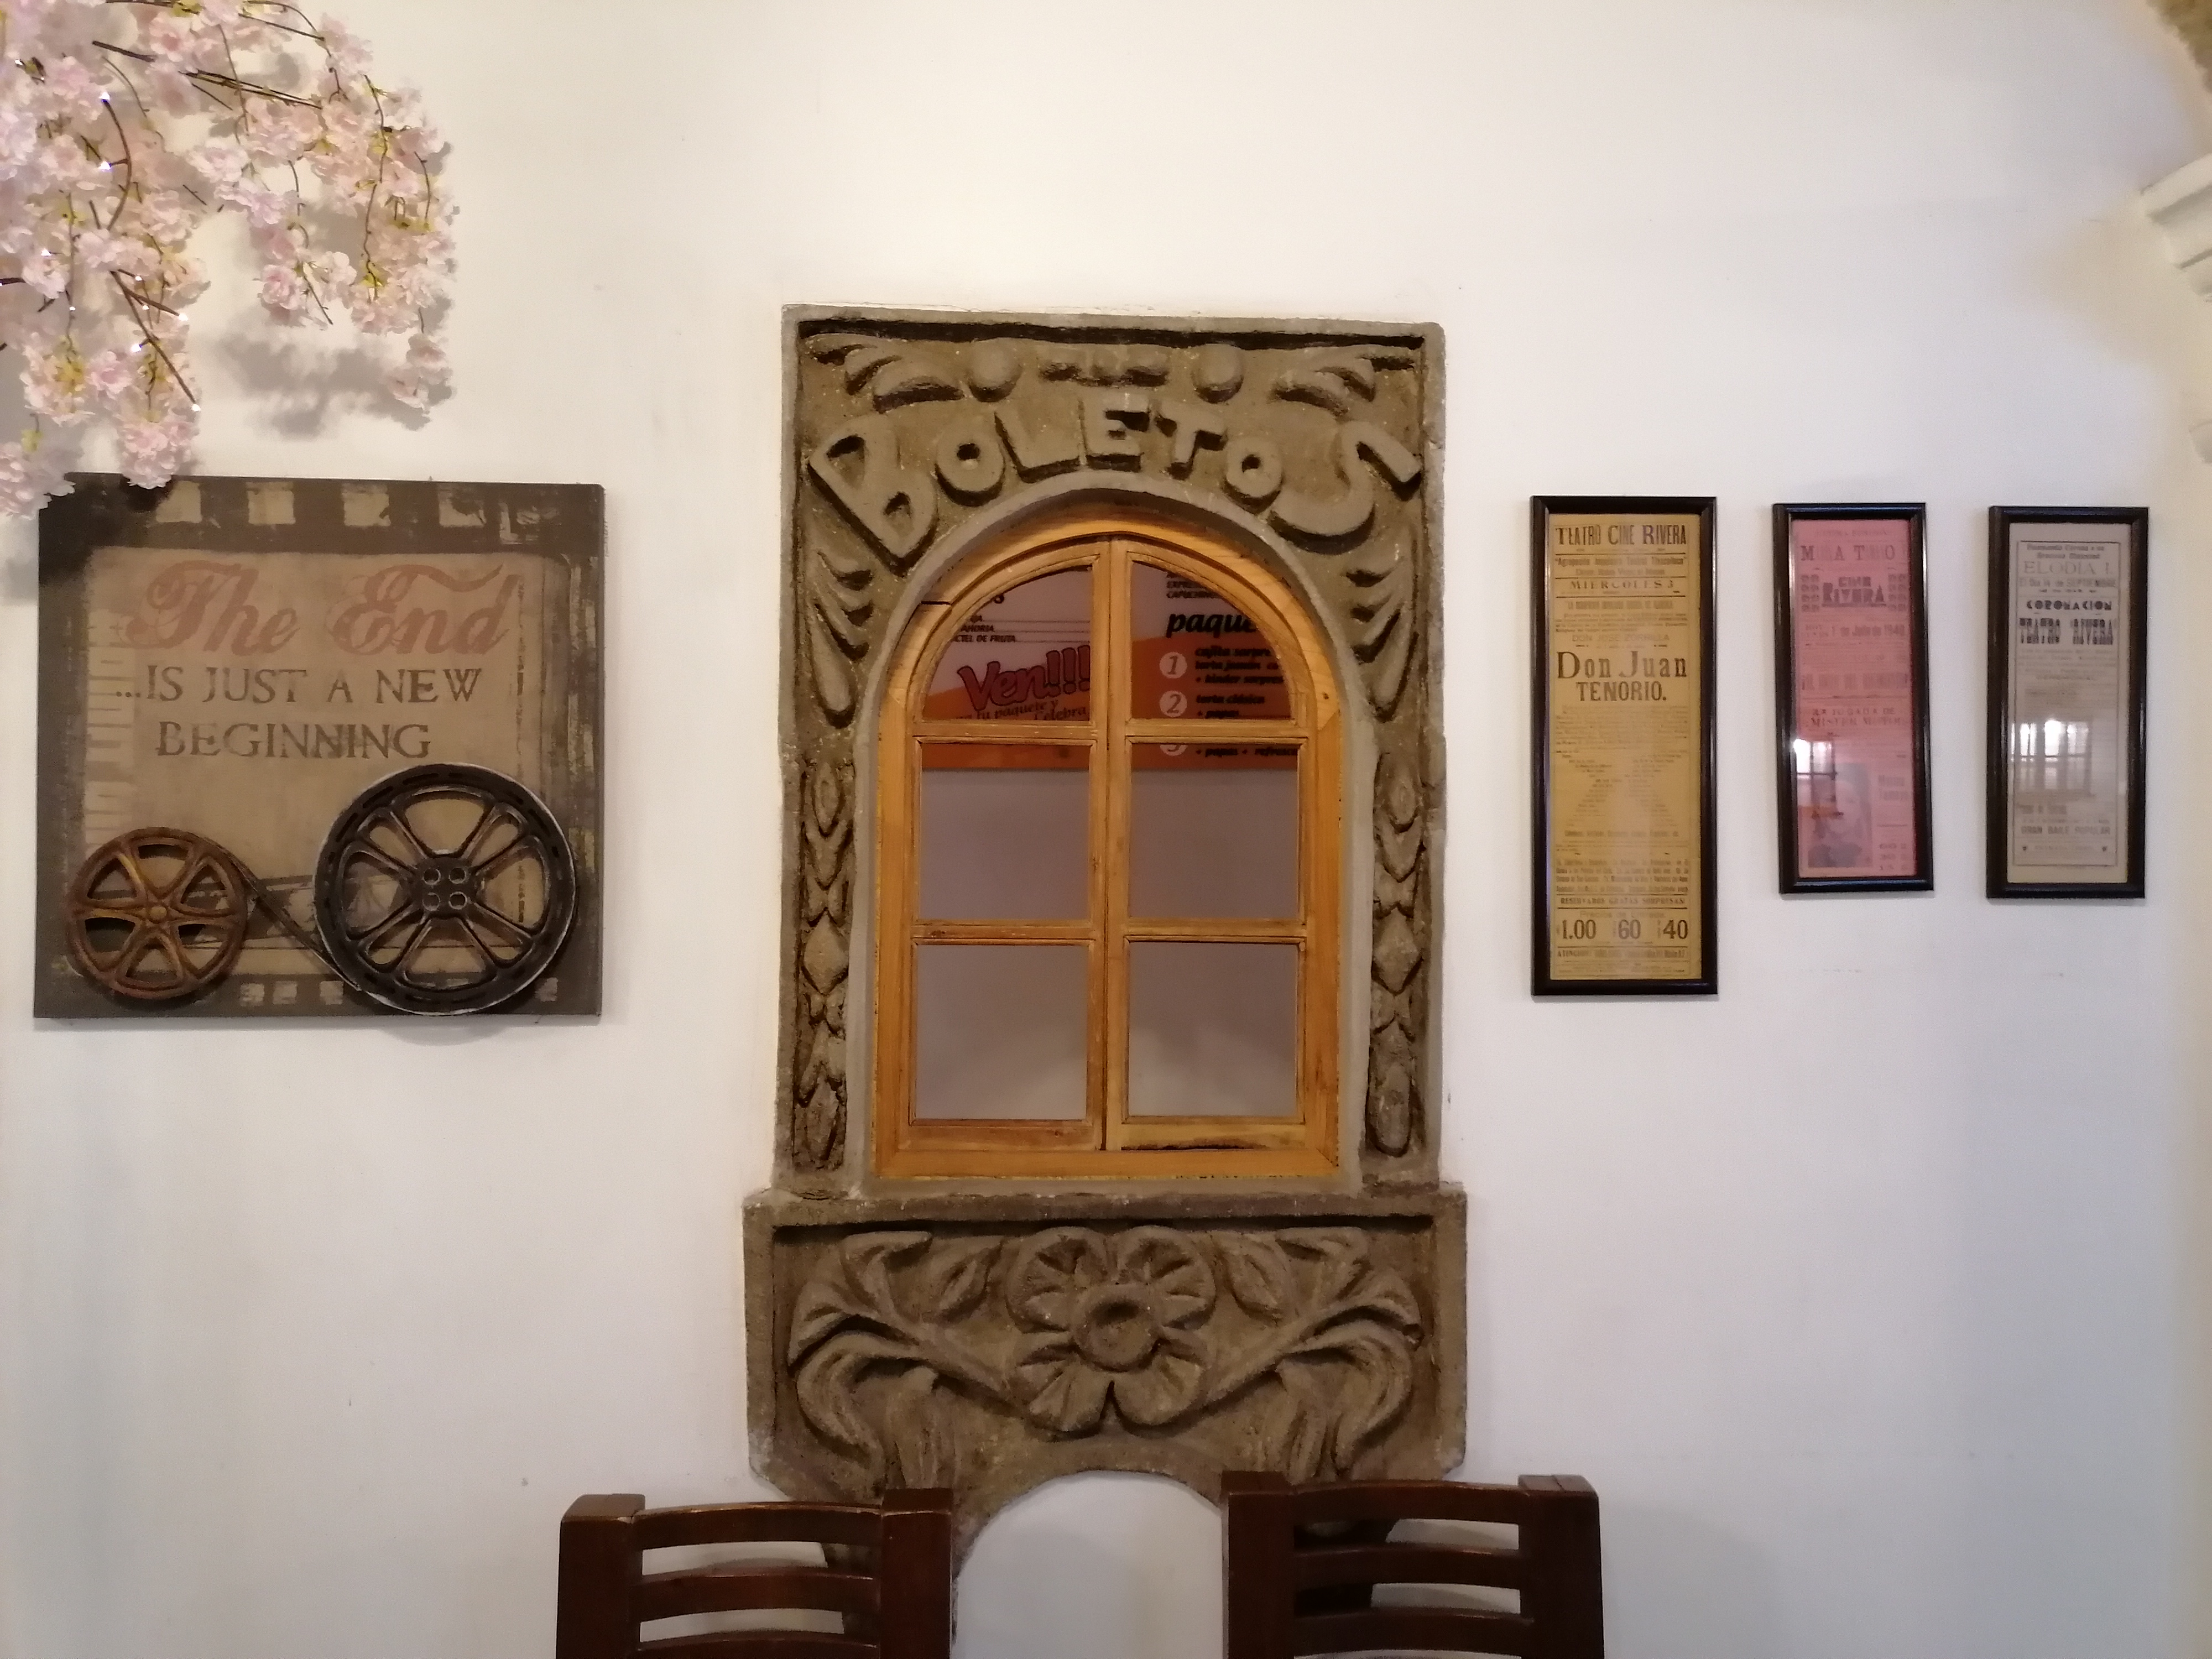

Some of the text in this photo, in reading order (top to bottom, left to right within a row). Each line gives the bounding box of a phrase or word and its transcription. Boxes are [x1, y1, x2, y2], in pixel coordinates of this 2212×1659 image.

[807, 393, 1423, 570] BOLETOS
[1643, 525, 1686, 545] RIVERA
[125, 560, 522, 656] The End
[2027, 600, 2112, 611] CORONACION
[1168, 655, 1178, 675] 1
[1556, 650, 1687, 679] Don Juan
[202, 668, 307, 703] JUST
[327, 669, 353, 703] A
[376, 668, 482, 703] NEW
[957, 645, 1090, 711] Ven!!!
[1576, 681, 1667, 701] TENORIO.
[1167, 694, 1181, 713] 2
[156, 721, 431, 758] BEGINNING
[1562, 919, 1597, 939] 1.00
[1618, 919, 1641, 939] 60
[1663, 919, 1688, 939] 40
